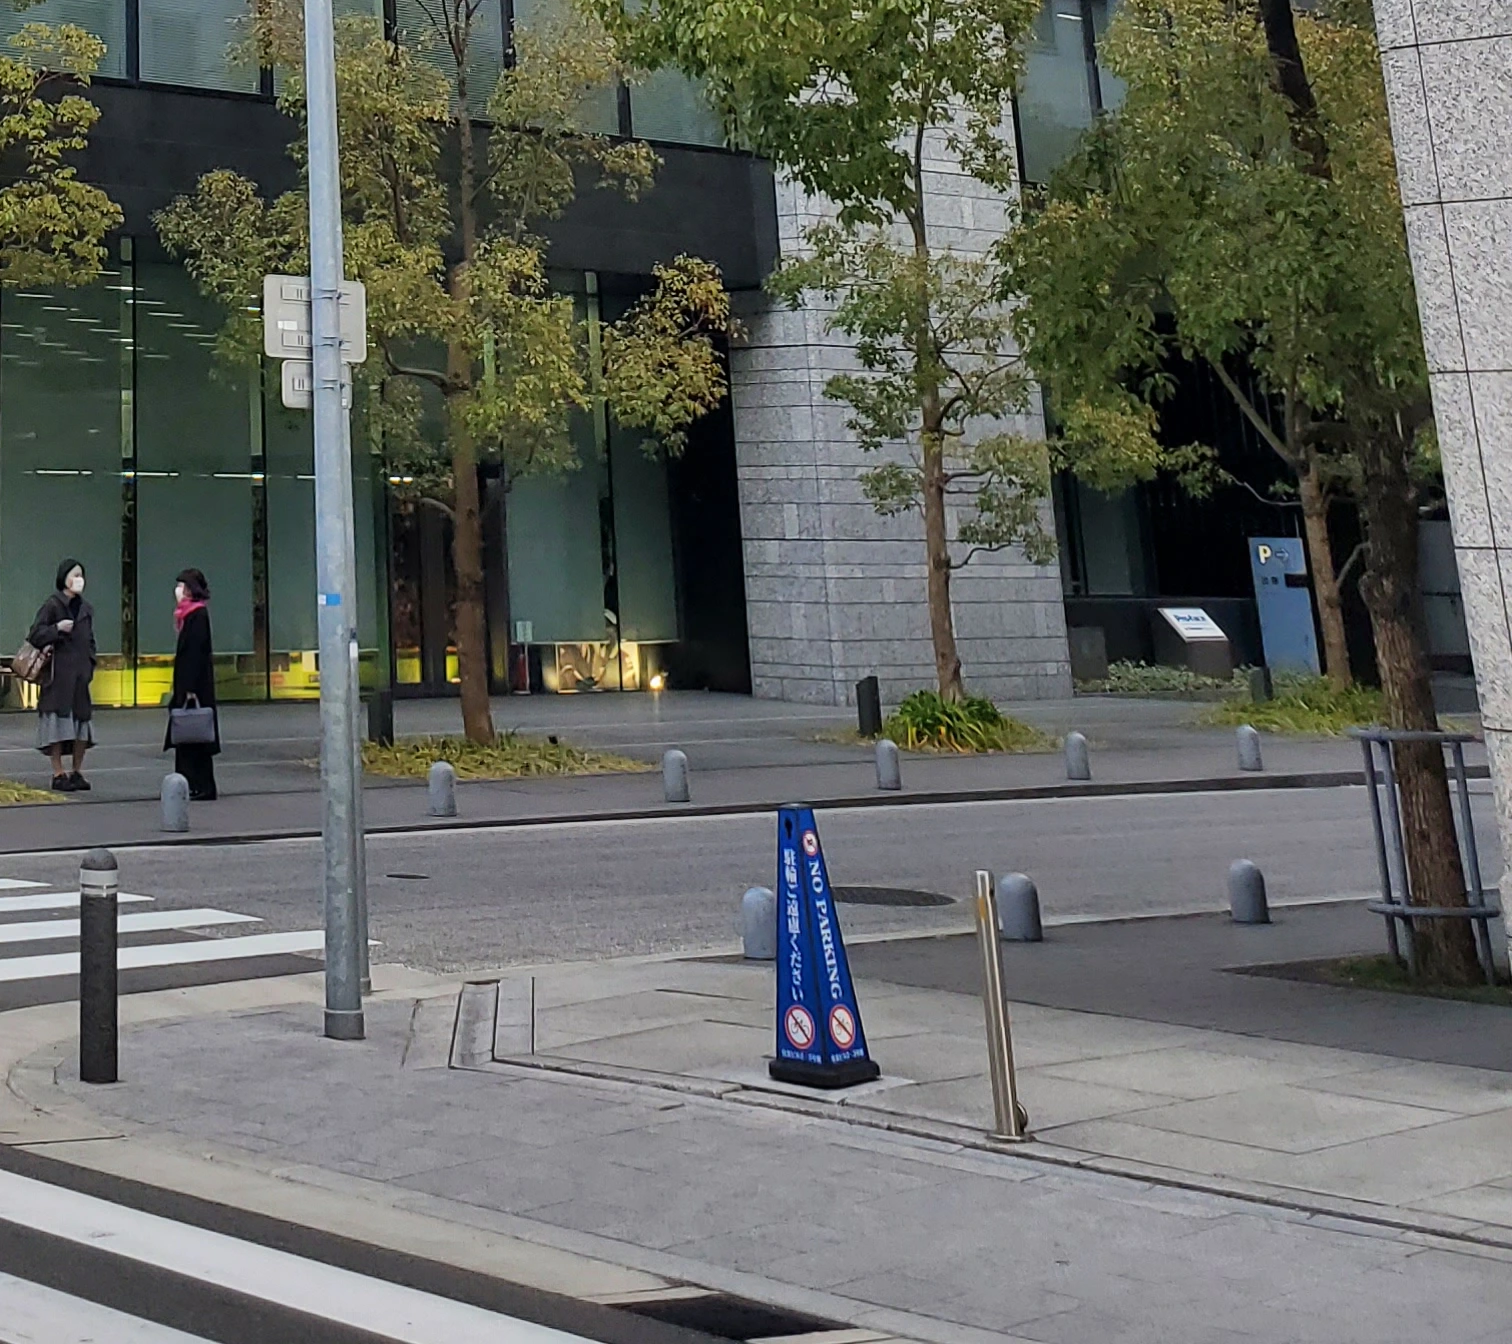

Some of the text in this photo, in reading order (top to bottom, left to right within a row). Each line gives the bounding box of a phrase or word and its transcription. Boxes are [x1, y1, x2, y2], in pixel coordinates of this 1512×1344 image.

[1257, 545, 1272, 564] P
[809, 860, 842, 999] NO PARKING
